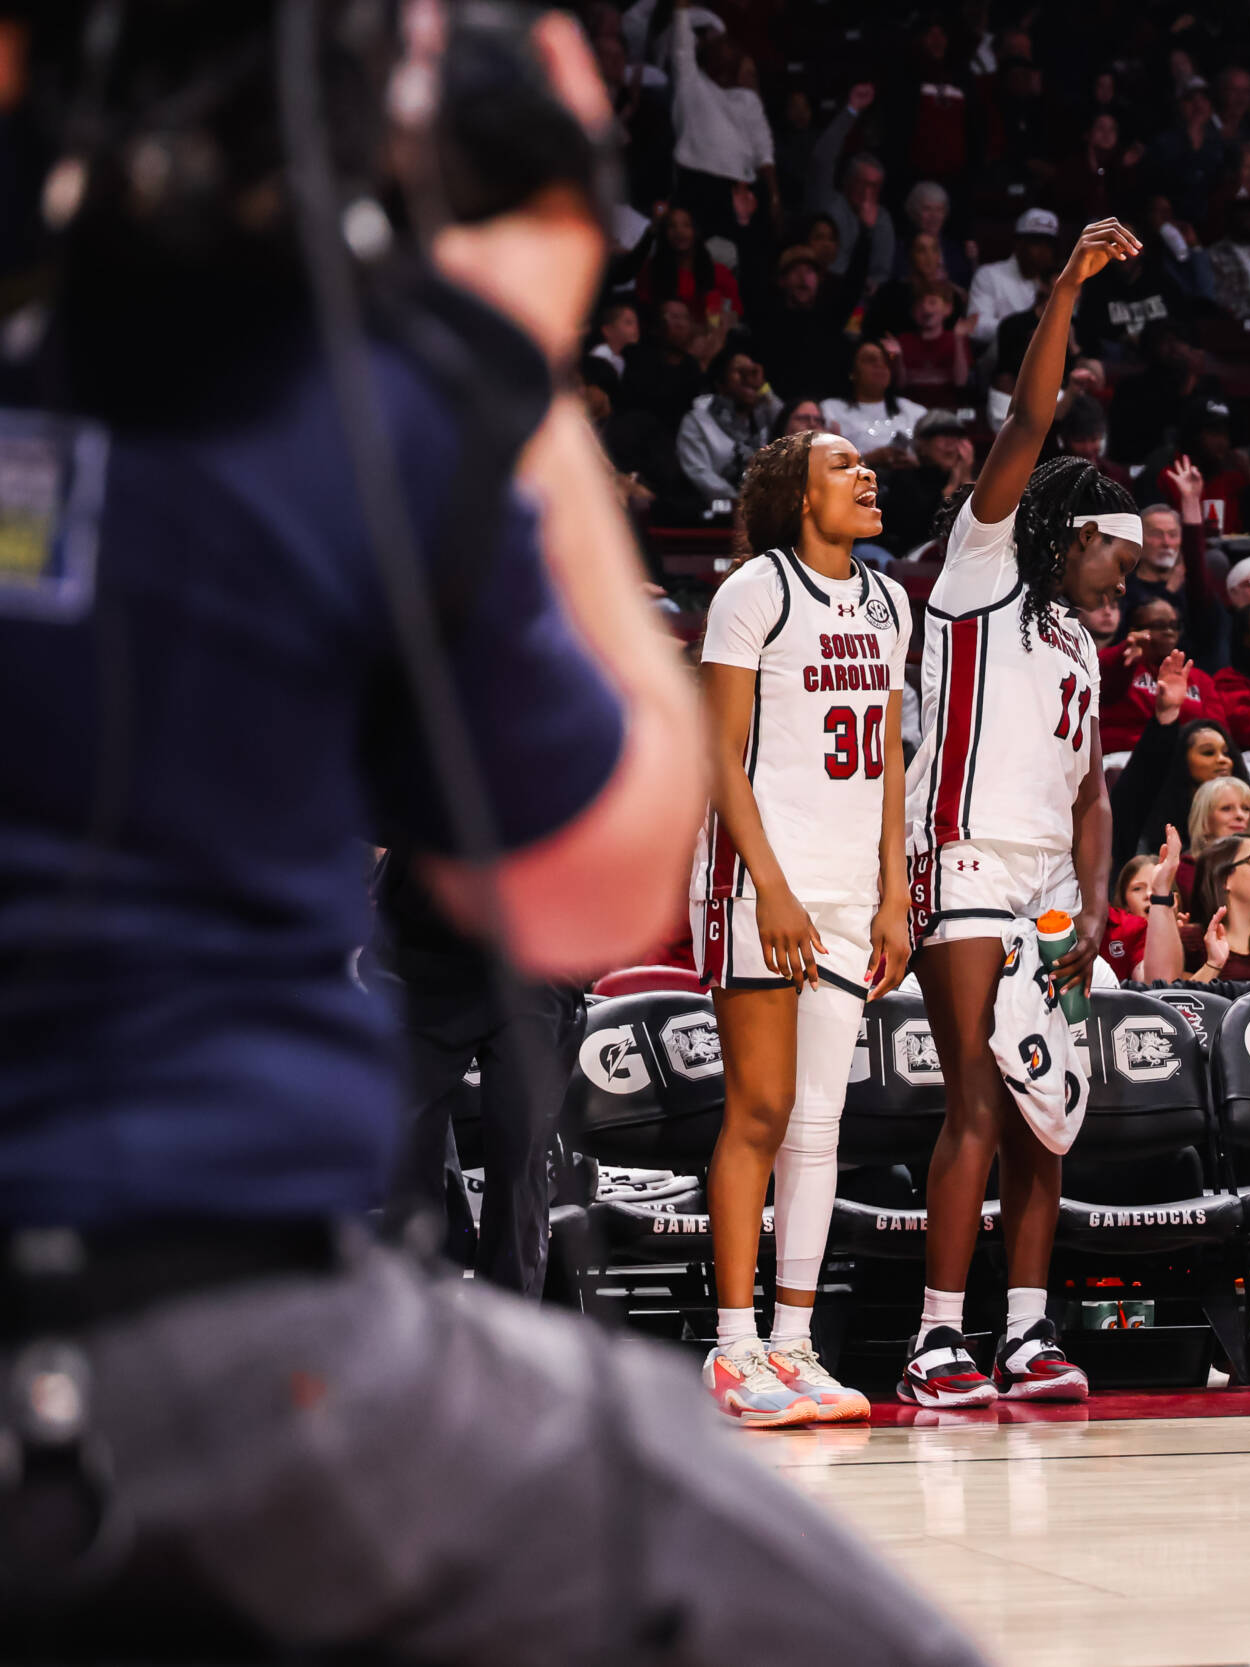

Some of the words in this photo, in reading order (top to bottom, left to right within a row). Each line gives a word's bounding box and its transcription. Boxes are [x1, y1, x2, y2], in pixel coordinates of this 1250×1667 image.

[819, 633, 881, 660] SOUTH
[1054, 671, 1091, 753] 11
[824, 705, 884, 780] 30
[653, 1216, 774, 1233] GAMES
[876, 1214, 994, 1231] GAMES
[1089, 1208, 1206, 1227] GAMECOCKS
